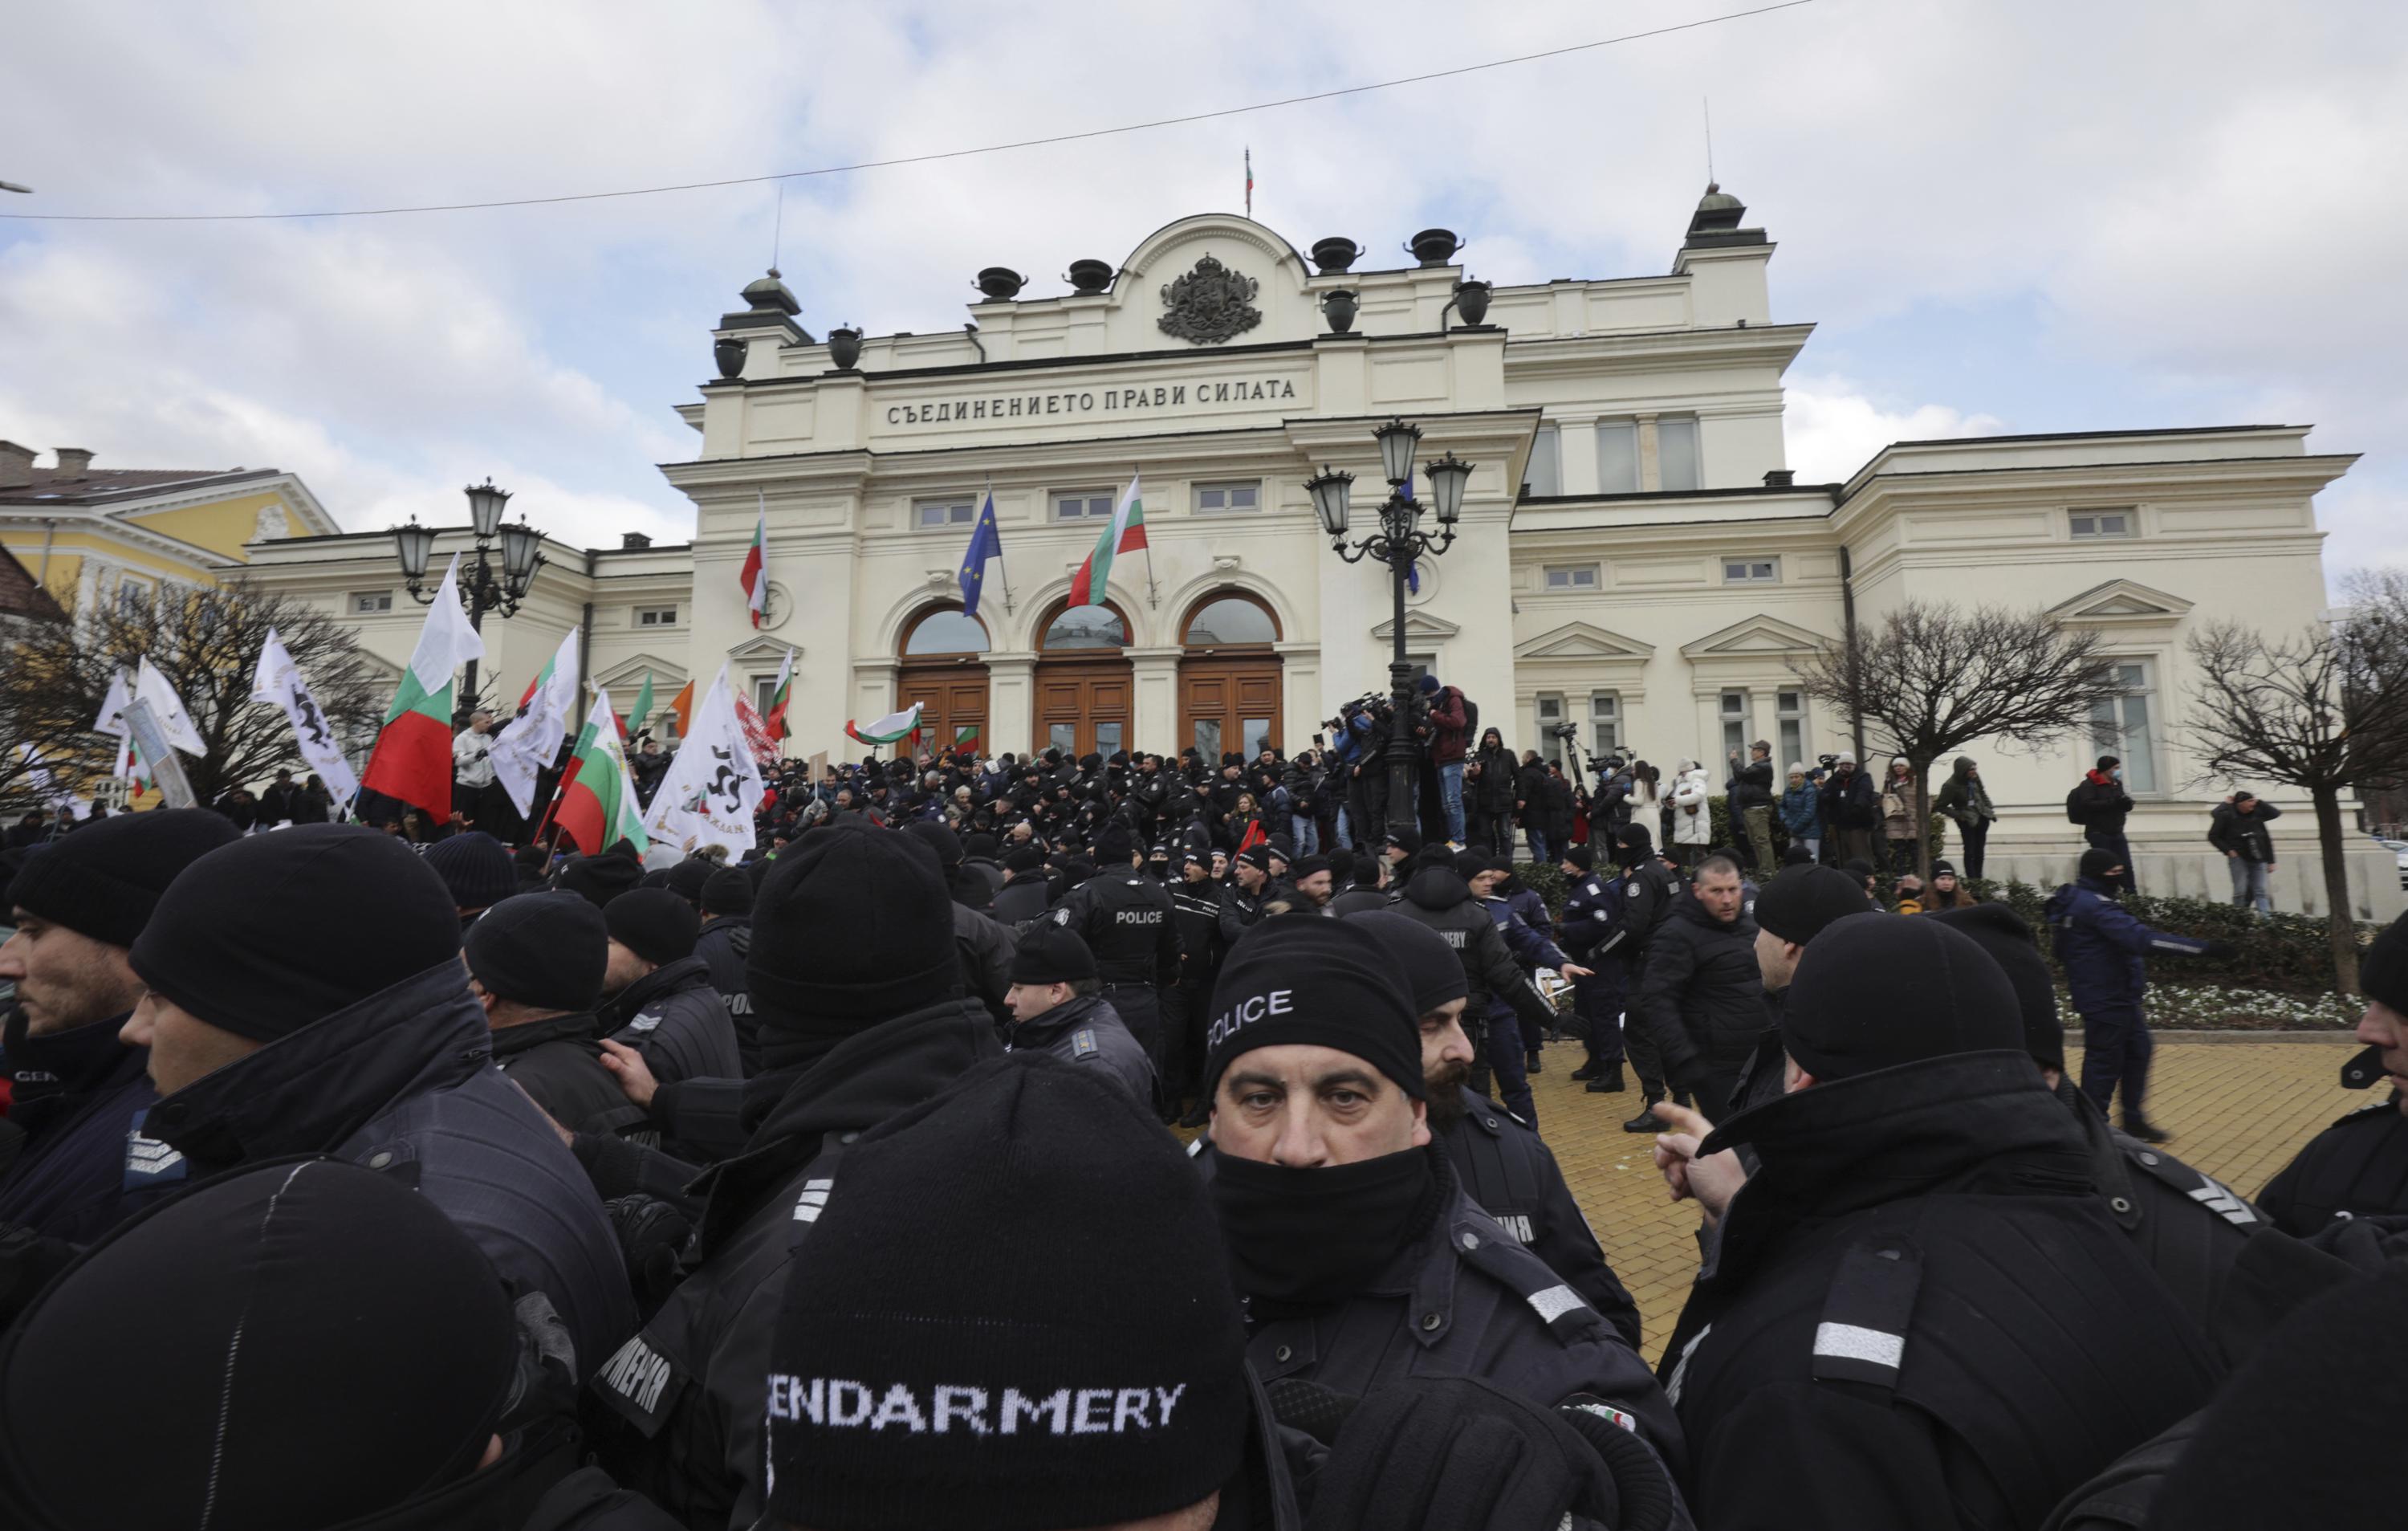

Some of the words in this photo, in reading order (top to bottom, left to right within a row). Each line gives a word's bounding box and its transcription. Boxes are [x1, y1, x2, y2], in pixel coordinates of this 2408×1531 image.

[887, 392, 1094, 426] СЪЕДИНЕНИЕТО
[1104, 385, 1186, 410] ПРАВИ
[1197, 379, 1296, 403] СИЛАТА
[1116, 910, 1163, 924] POLICE
[1202, 906, 1219, 915] POLICE
[1206, 989, 1294, 1055] POLICE
[767, 1374, 1187, 1435] ENDARMERY
